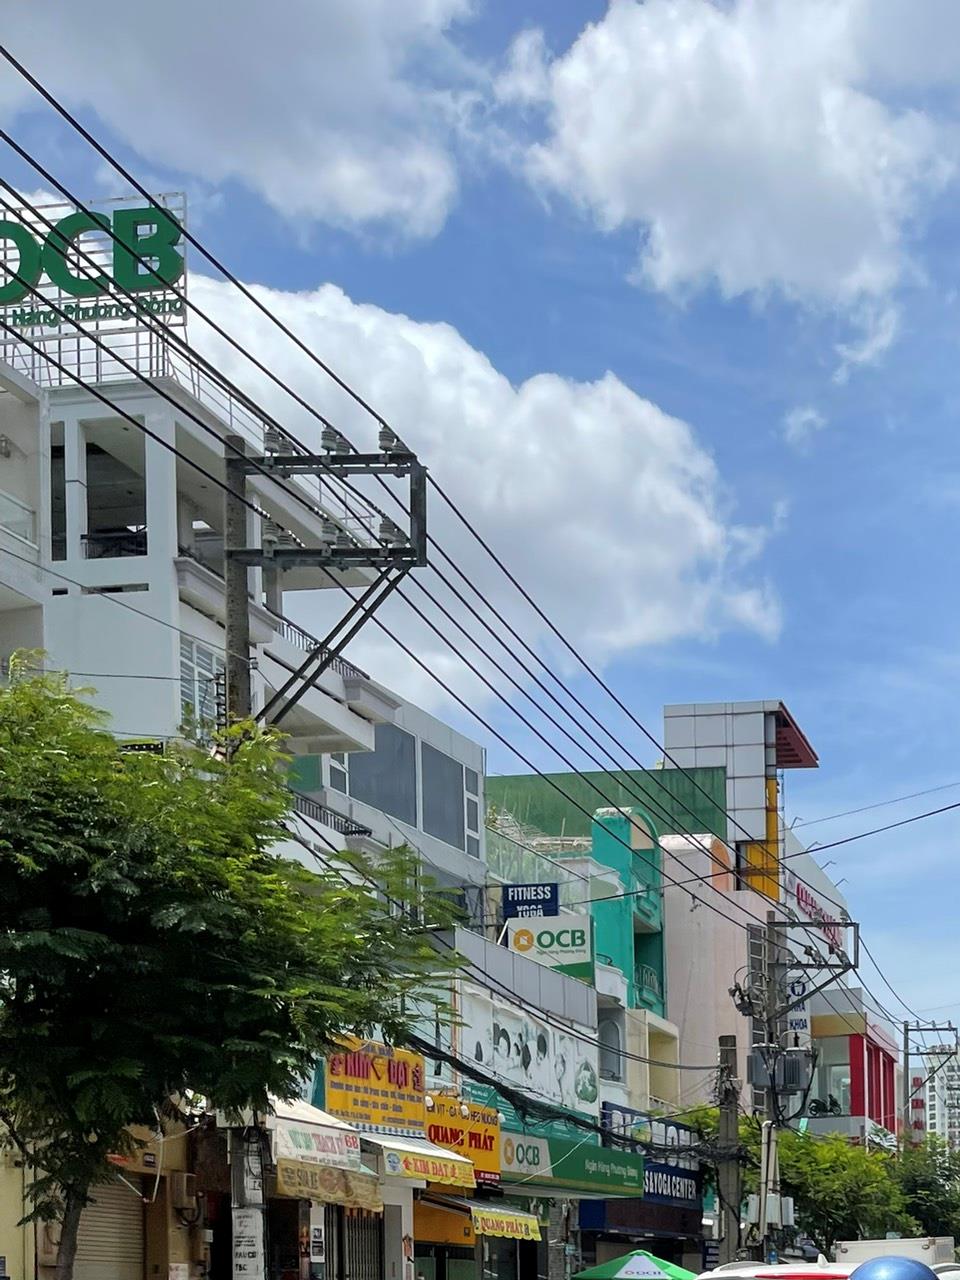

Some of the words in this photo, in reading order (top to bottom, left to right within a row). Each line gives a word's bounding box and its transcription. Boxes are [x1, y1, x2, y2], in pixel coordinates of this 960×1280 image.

[508, 885, 551, 901] FITNESS
[516, 904, 544, 918] YOGA
[536, 929, 586, 949] OCB
[344, 1134, 359, 1150] 68
[428, 1123, 465, 1147] QUANG
[468, 1128, 496, 1152] PHÁT
[515, 1142, 540, 1166] OCB
[671, 1175, 697, 1200] CENTER
